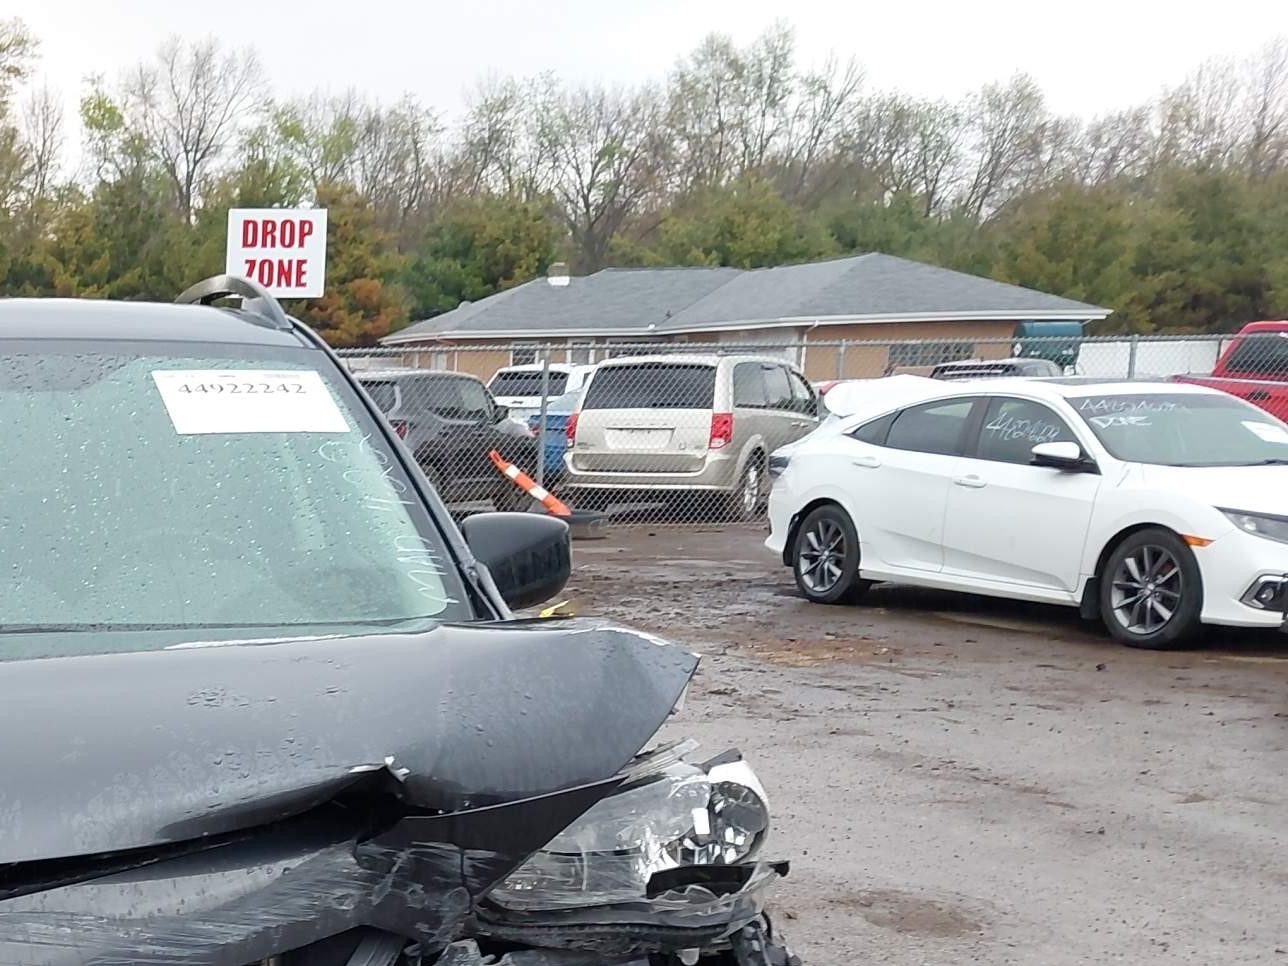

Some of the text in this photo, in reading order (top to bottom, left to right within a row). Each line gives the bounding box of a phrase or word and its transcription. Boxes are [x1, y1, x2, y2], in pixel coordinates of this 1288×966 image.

[242, 219, 313, 248] DROP
[244, 259, 308, 288] ZONE
[178, 383, 308, 394] 44922242
